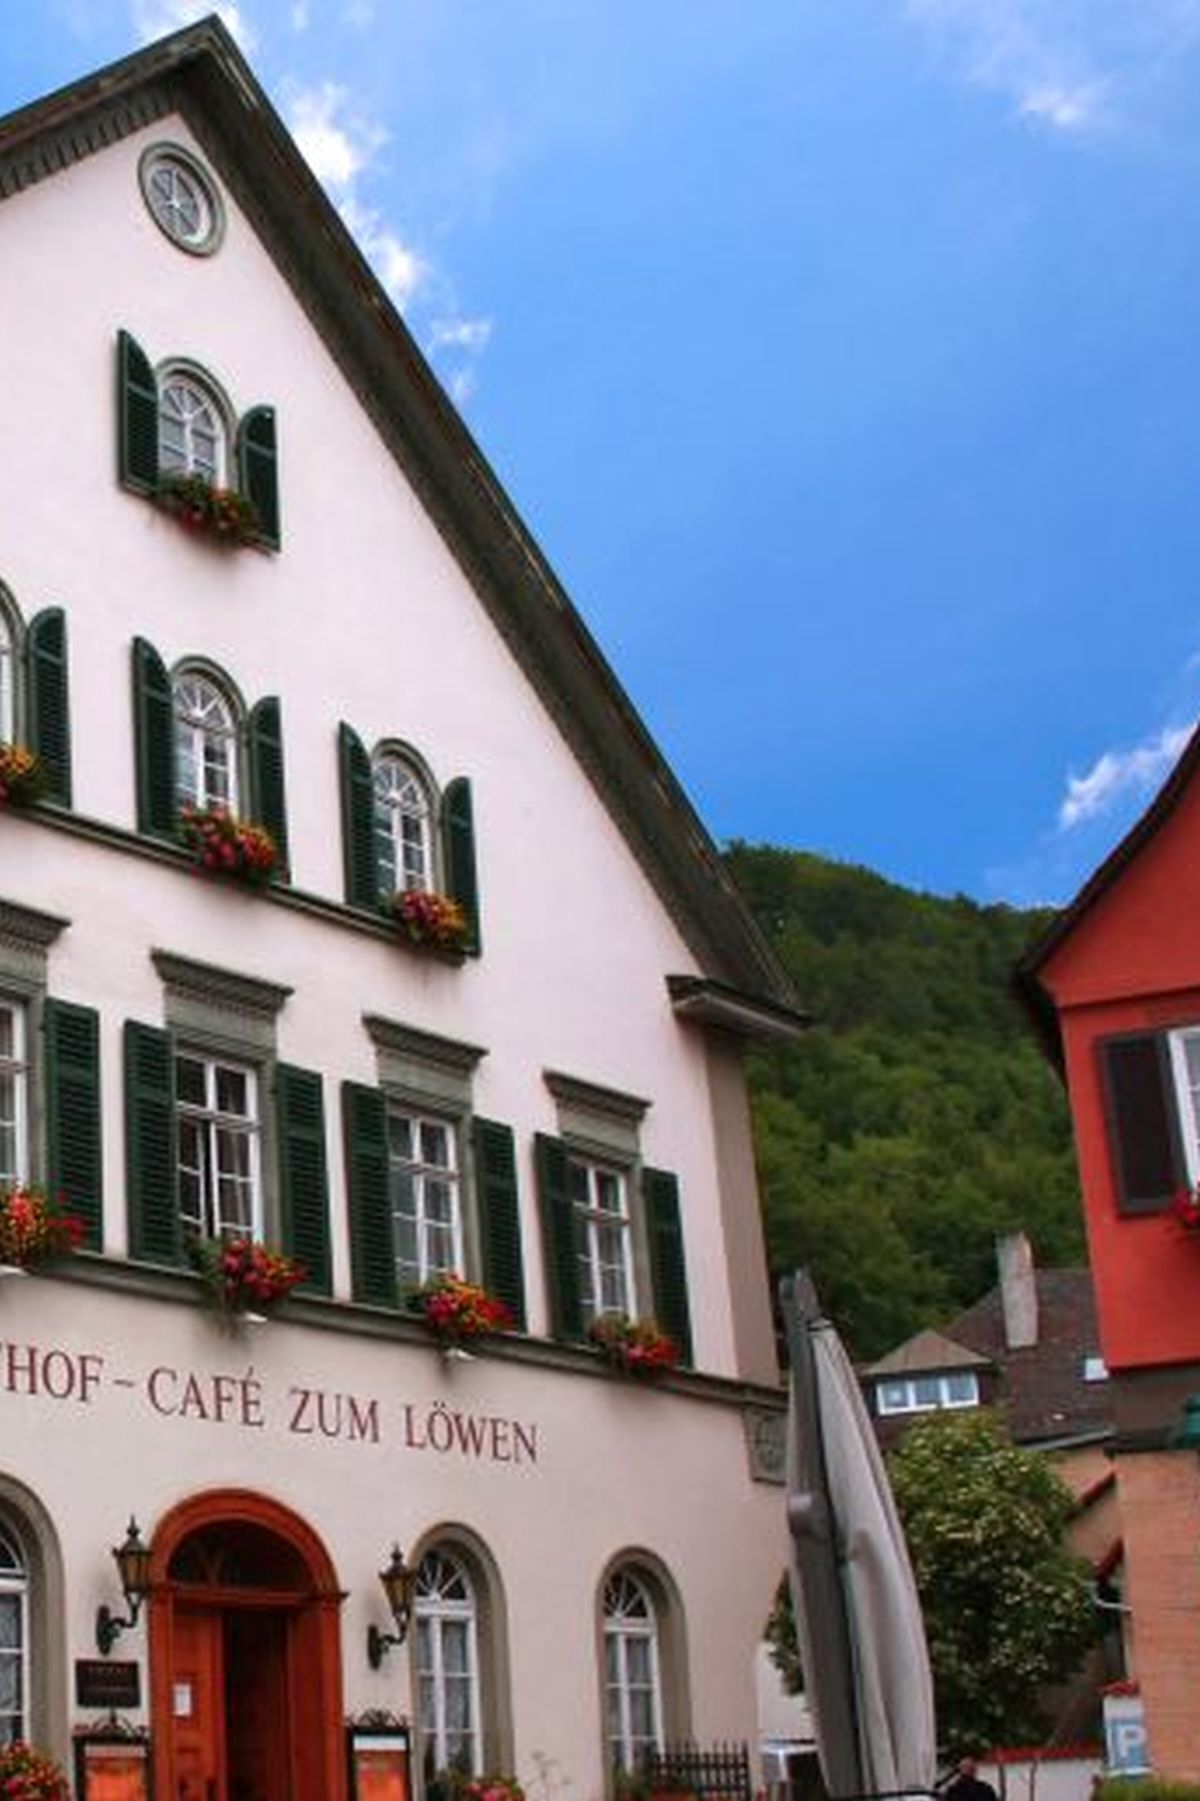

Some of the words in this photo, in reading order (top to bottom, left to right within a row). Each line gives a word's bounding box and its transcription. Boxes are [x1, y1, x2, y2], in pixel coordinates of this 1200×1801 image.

[147, 1364, 265, 1427] CAFÉ
[289, 1388, 380, 1443] ZUM
[404, 1401, 538, 1464] LÖWEN
[1116, 1724, 1147, 1759] P
